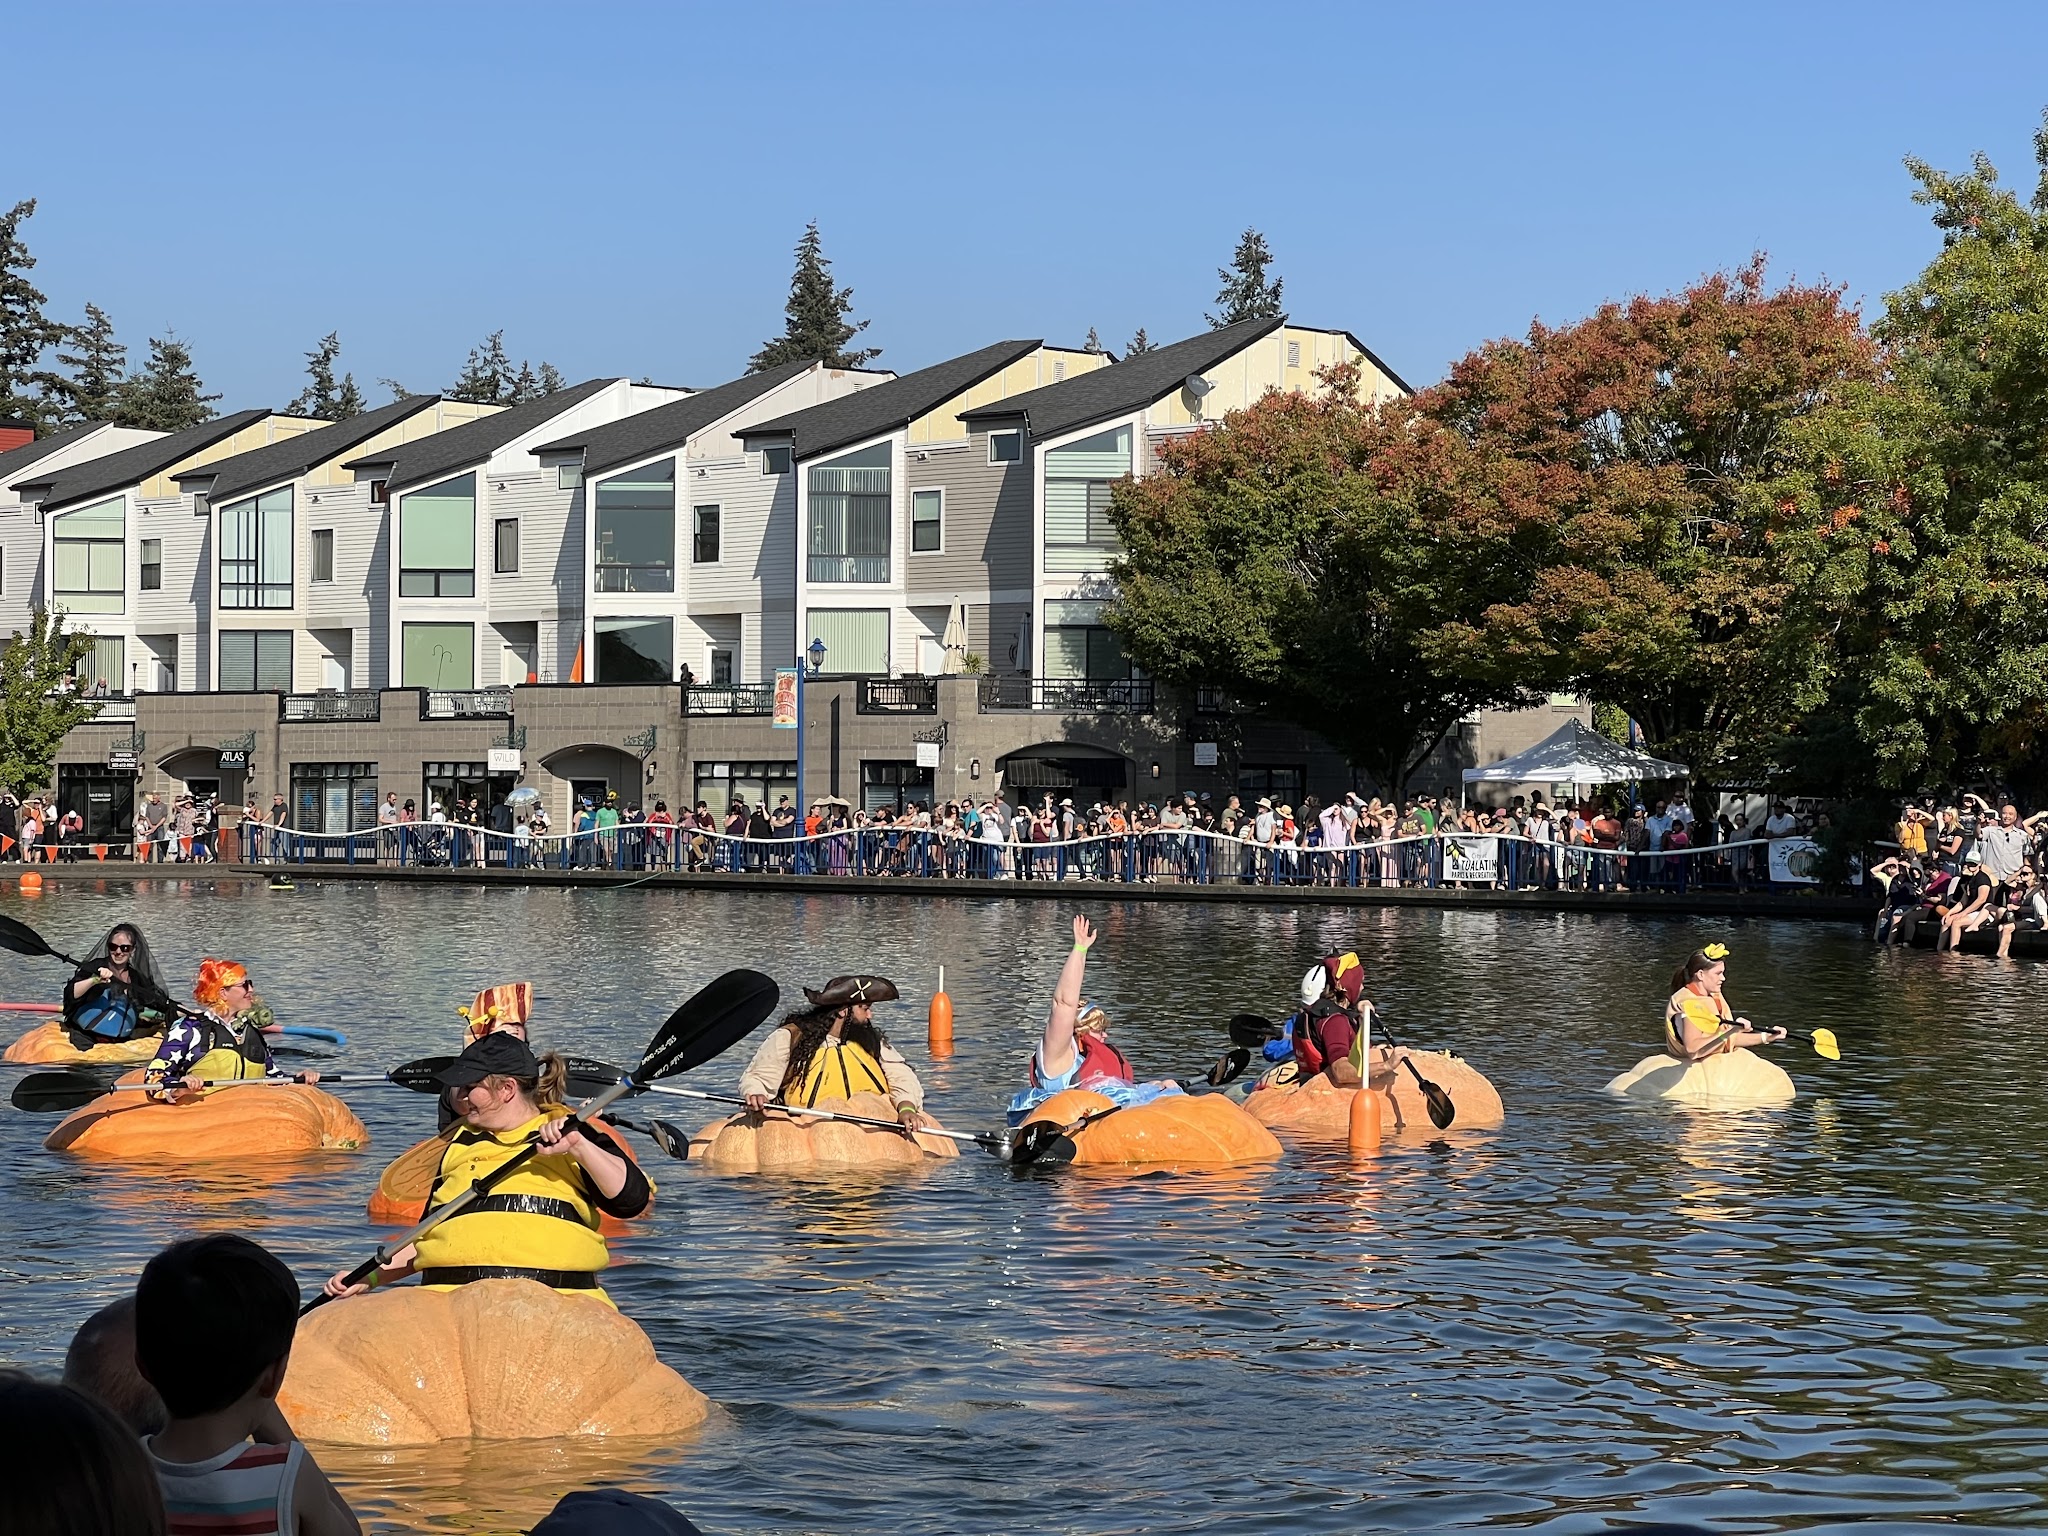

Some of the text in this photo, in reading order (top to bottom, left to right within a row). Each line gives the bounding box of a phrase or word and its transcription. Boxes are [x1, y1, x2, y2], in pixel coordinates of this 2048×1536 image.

[220, 751, 245, 762] ATLAS
[493, 752, 515, 763] WILD
[1462, 860, 1497, 871] TUALATIN
